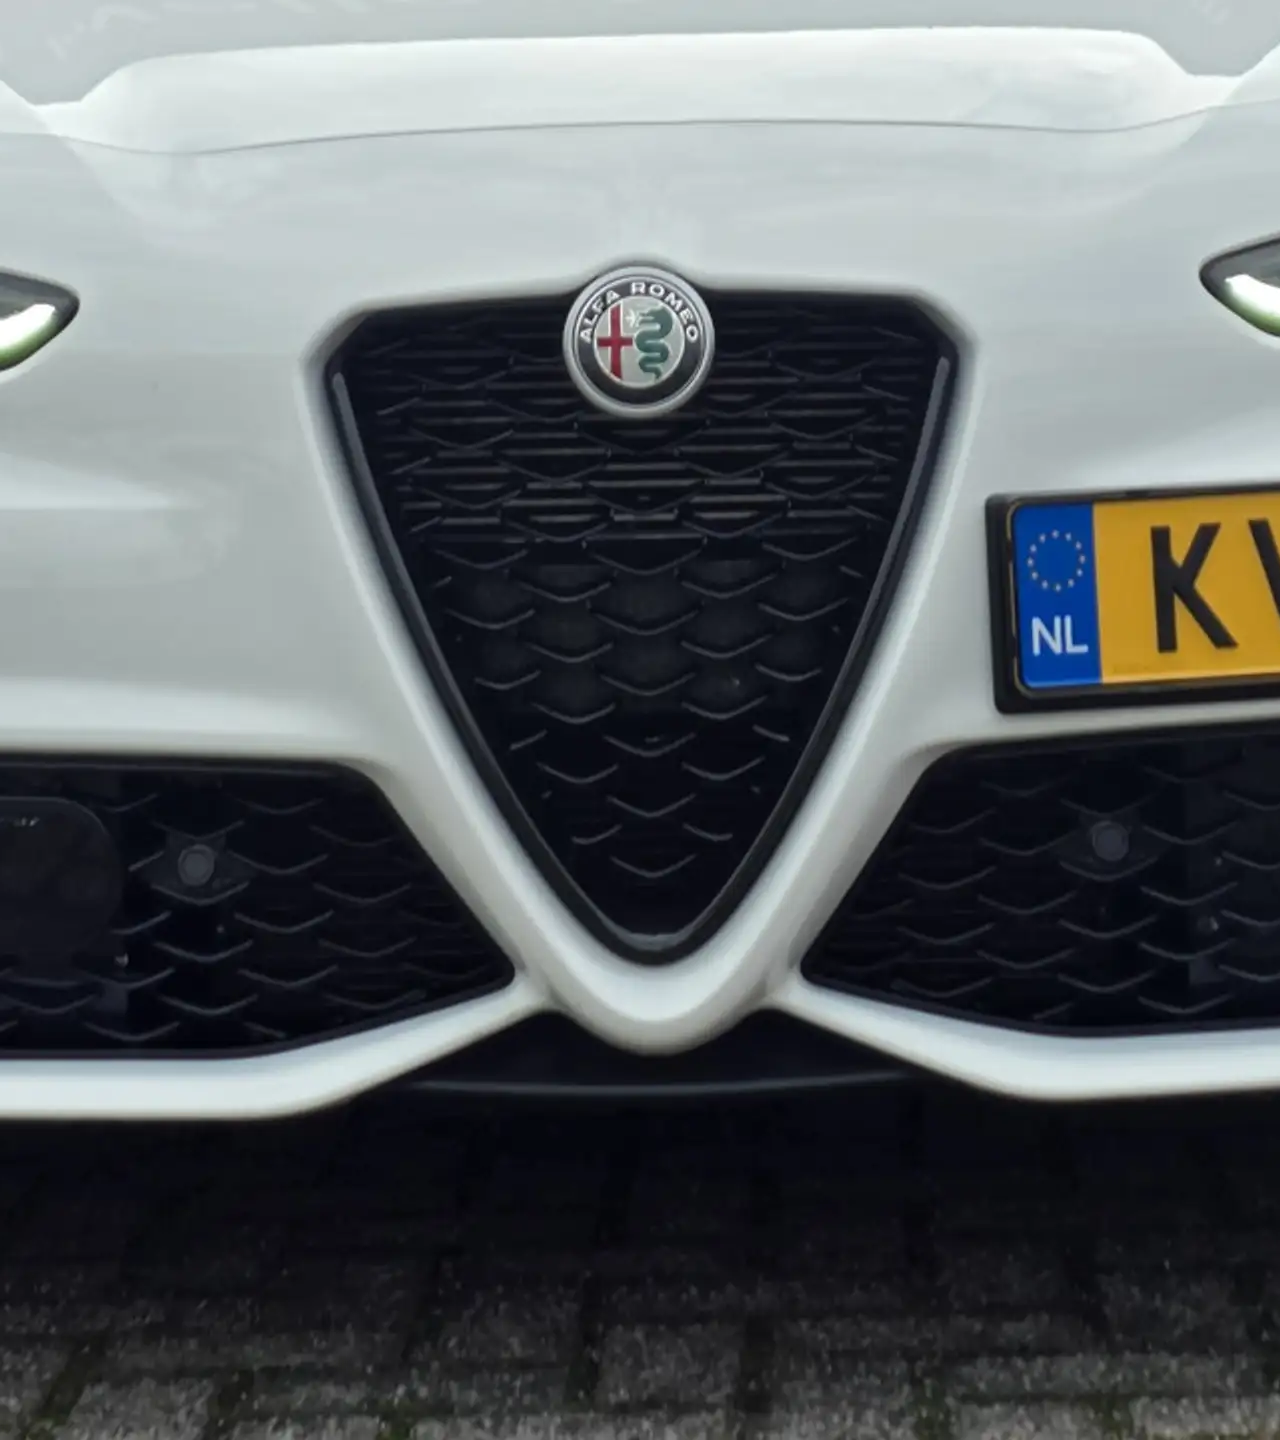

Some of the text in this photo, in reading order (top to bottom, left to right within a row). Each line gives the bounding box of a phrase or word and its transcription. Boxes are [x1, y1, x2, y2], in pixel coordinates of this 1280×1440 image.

[579, 281, 700, 344] ALFA ROMEO
[1030, 615, 1089, 656] NL
